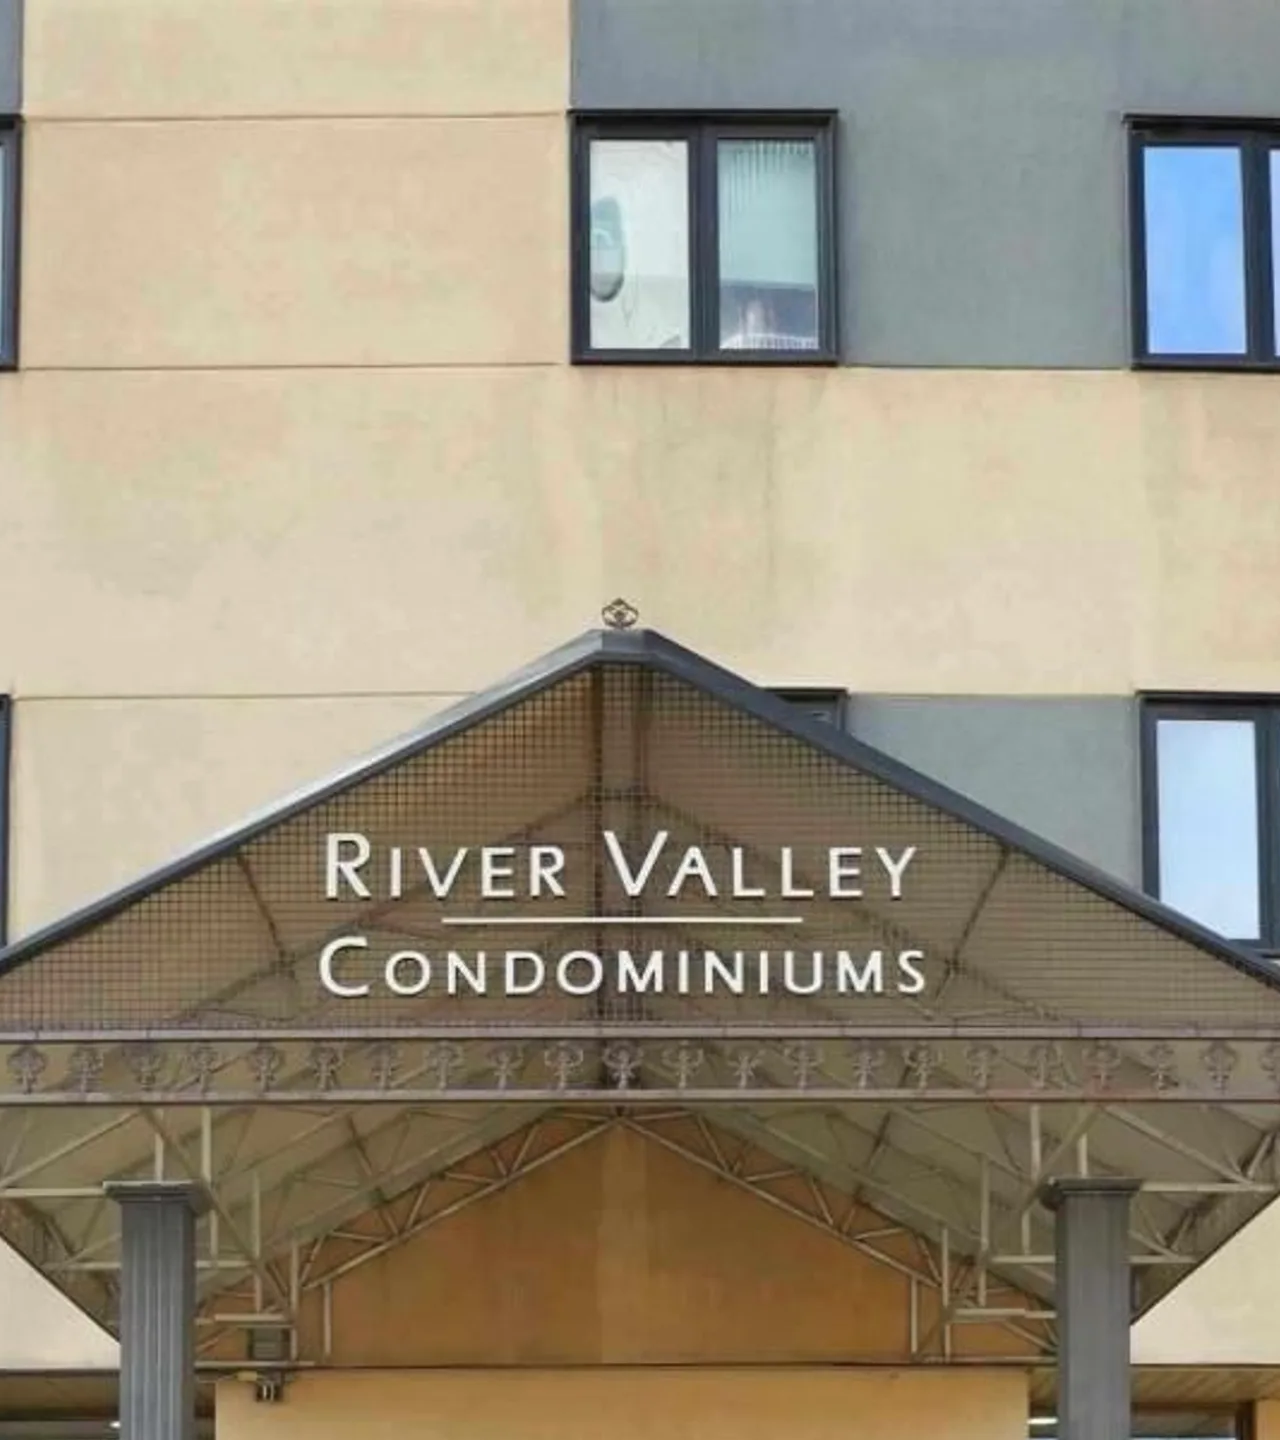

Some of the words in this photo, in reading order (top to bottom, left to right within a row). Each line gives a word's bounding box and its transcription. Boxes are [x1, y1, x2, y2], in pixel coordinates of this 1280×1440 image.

[325, 832, 566, 898] RIVER
[603, 831, 917, 898] VALLEY
[319, 936, 926, 996] CONDOMINIUMS
